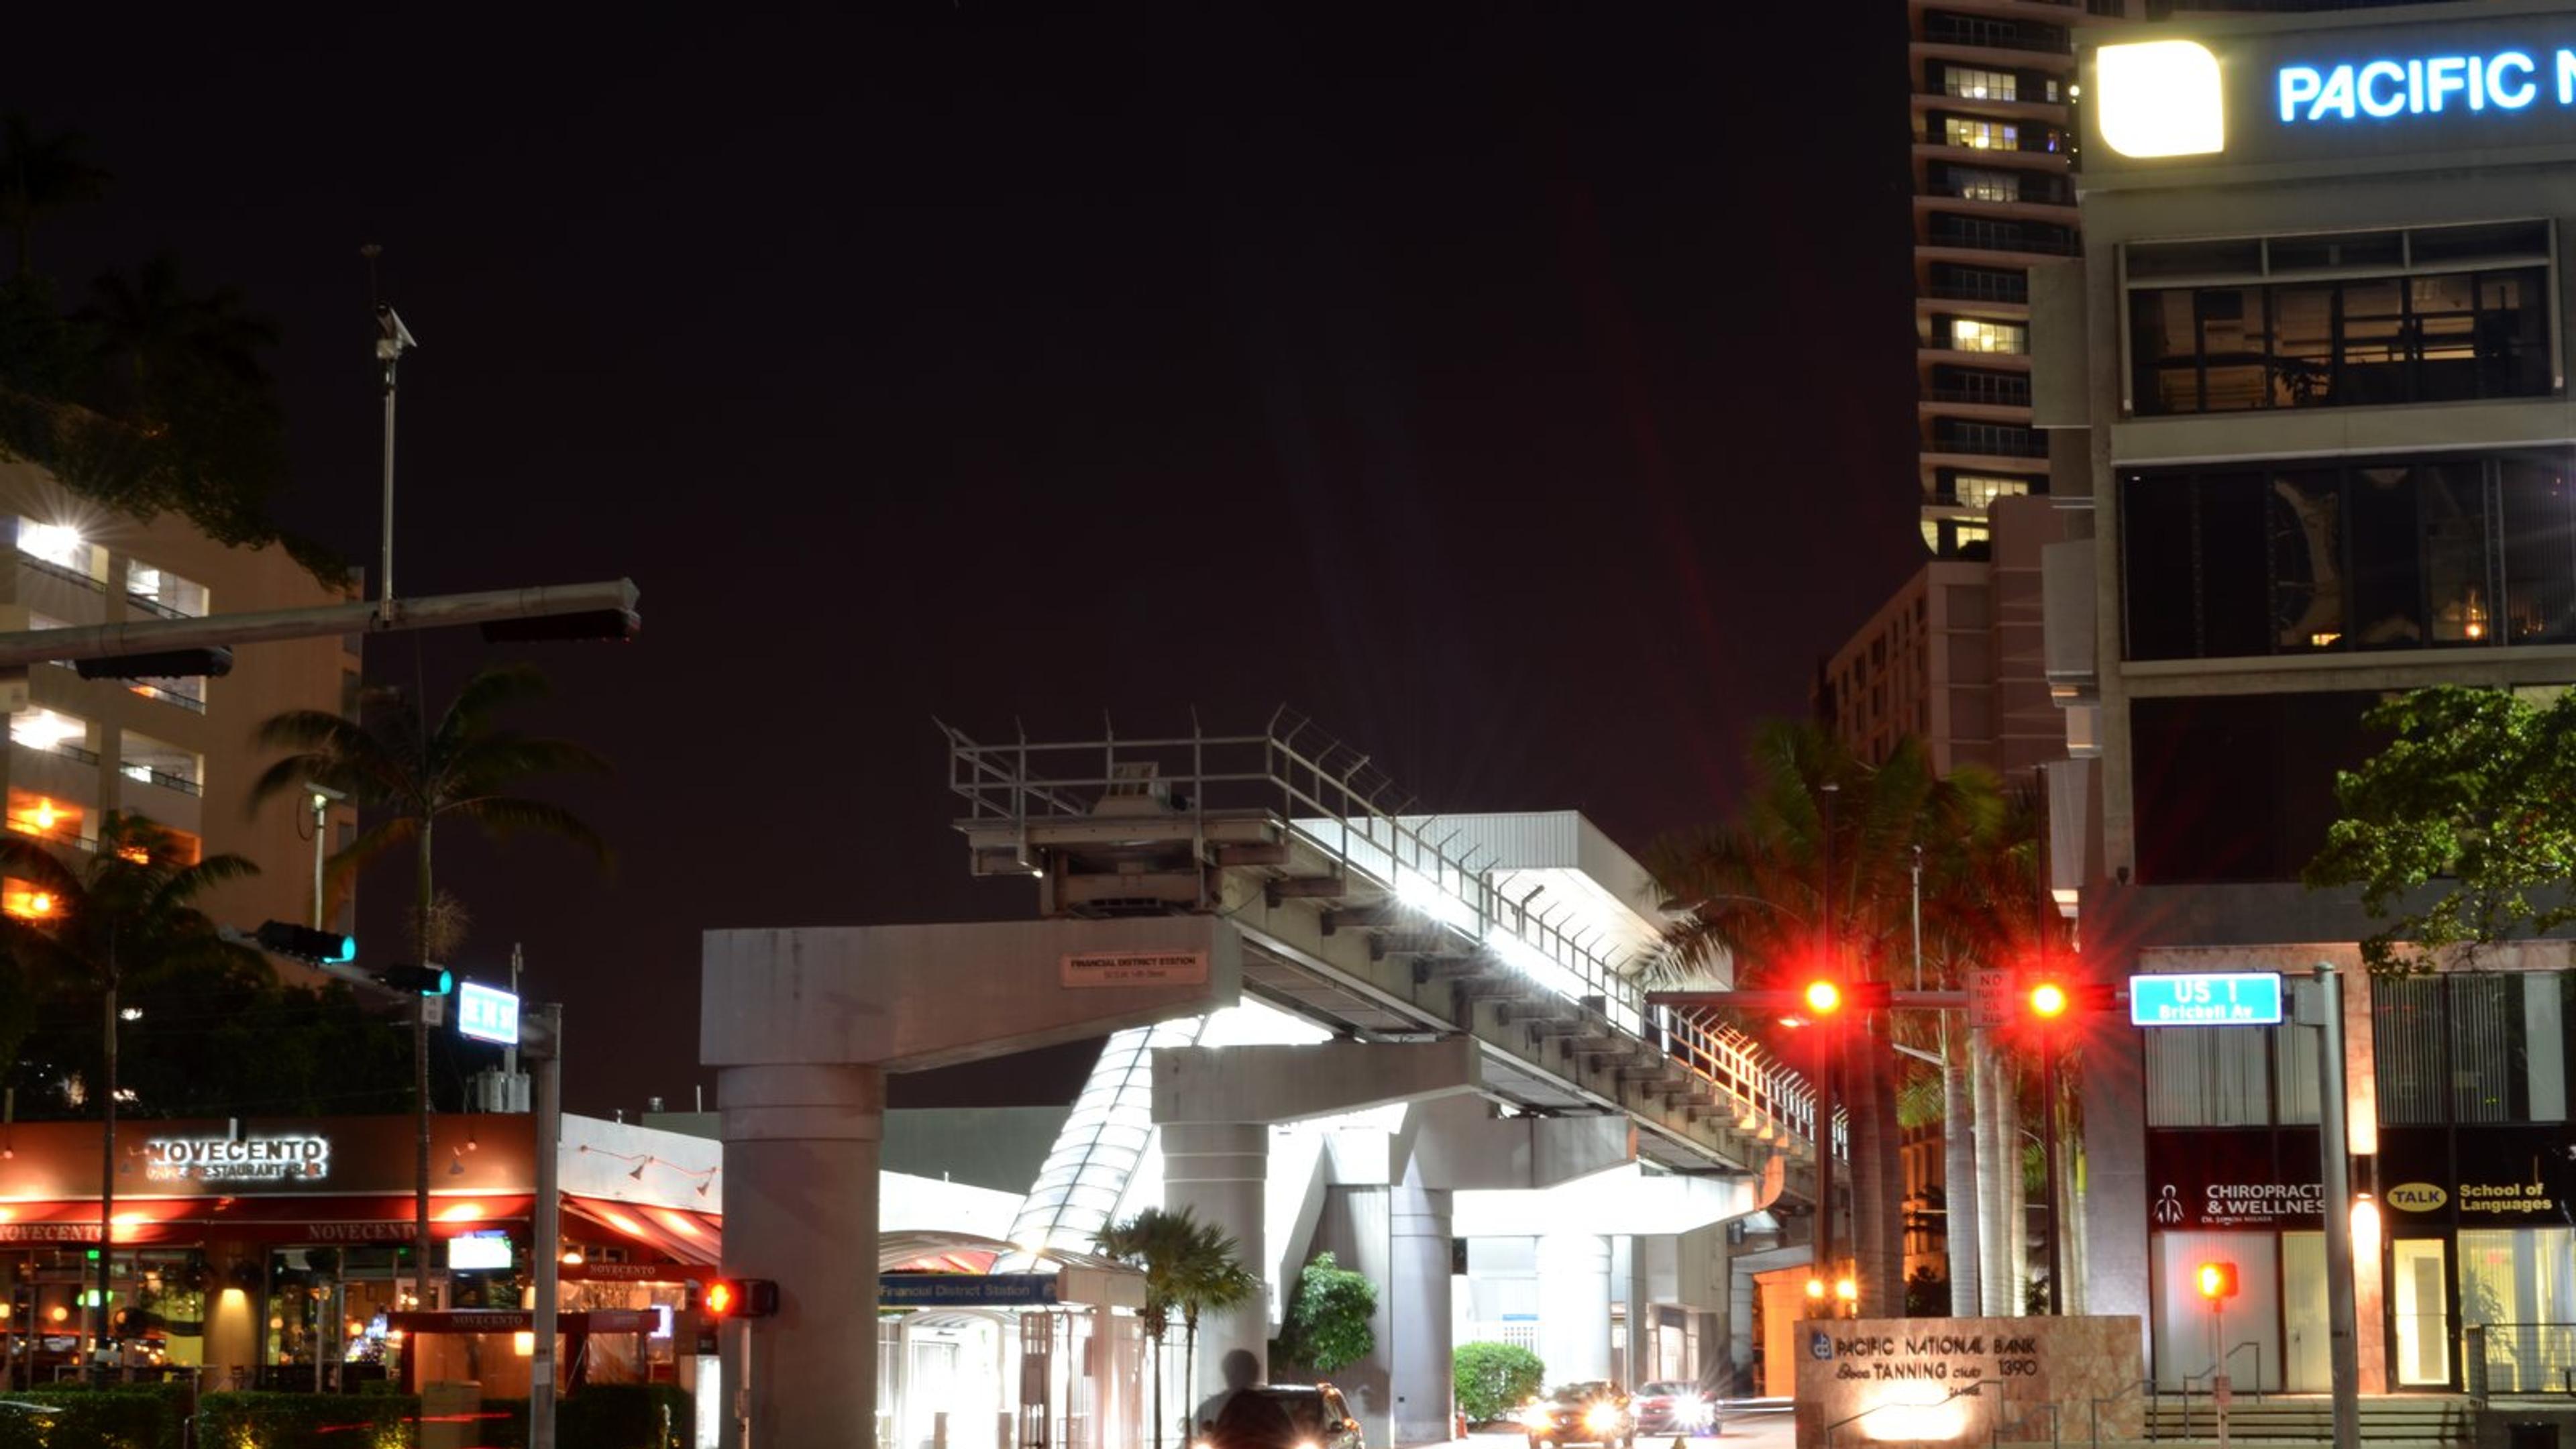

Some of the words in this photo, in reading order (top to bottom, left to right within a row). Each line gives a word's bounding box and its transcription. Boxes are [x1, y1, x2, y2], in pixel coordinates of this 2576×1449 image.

[2279, 51, 2536, 122] PACIFIC
[1118, 957, 1157, 967] DISTRICT
[1980, 973, 2002, 986] NO
[2174, 980, 2211, 1004] US
[2227, 980, 2237, 1004] 1
[148, 1140, 322, 1163] NOVECENTO
[2395, 1191, 2440, 1203] TALK
[2459, 1183, 2520, 1197] School
[2525, 1183, 2544, 1196] of
[2207, 1200, 2222, 1214] &
[2459, 1199, 2553, 1213] Languages
[590, 1265, 655, 1275] NOVECENTO
[879, 1284, 932, 1297] Financial
[935, 1283, 981, 1297] District
[985, 1283, 1030, 1297] Station
[451, 1315, 524, 1326] NOVECENTO
[1835, 1336, 1894, 1356] PACIFIC
[1906, 1335, 1984, 1355] NATIONAL
[1993, 1337, 2037, 1355] BANK
[1872, 1362, 1947, 1380] TANNING
[1998, 1359, 2038, 1376] 1390
